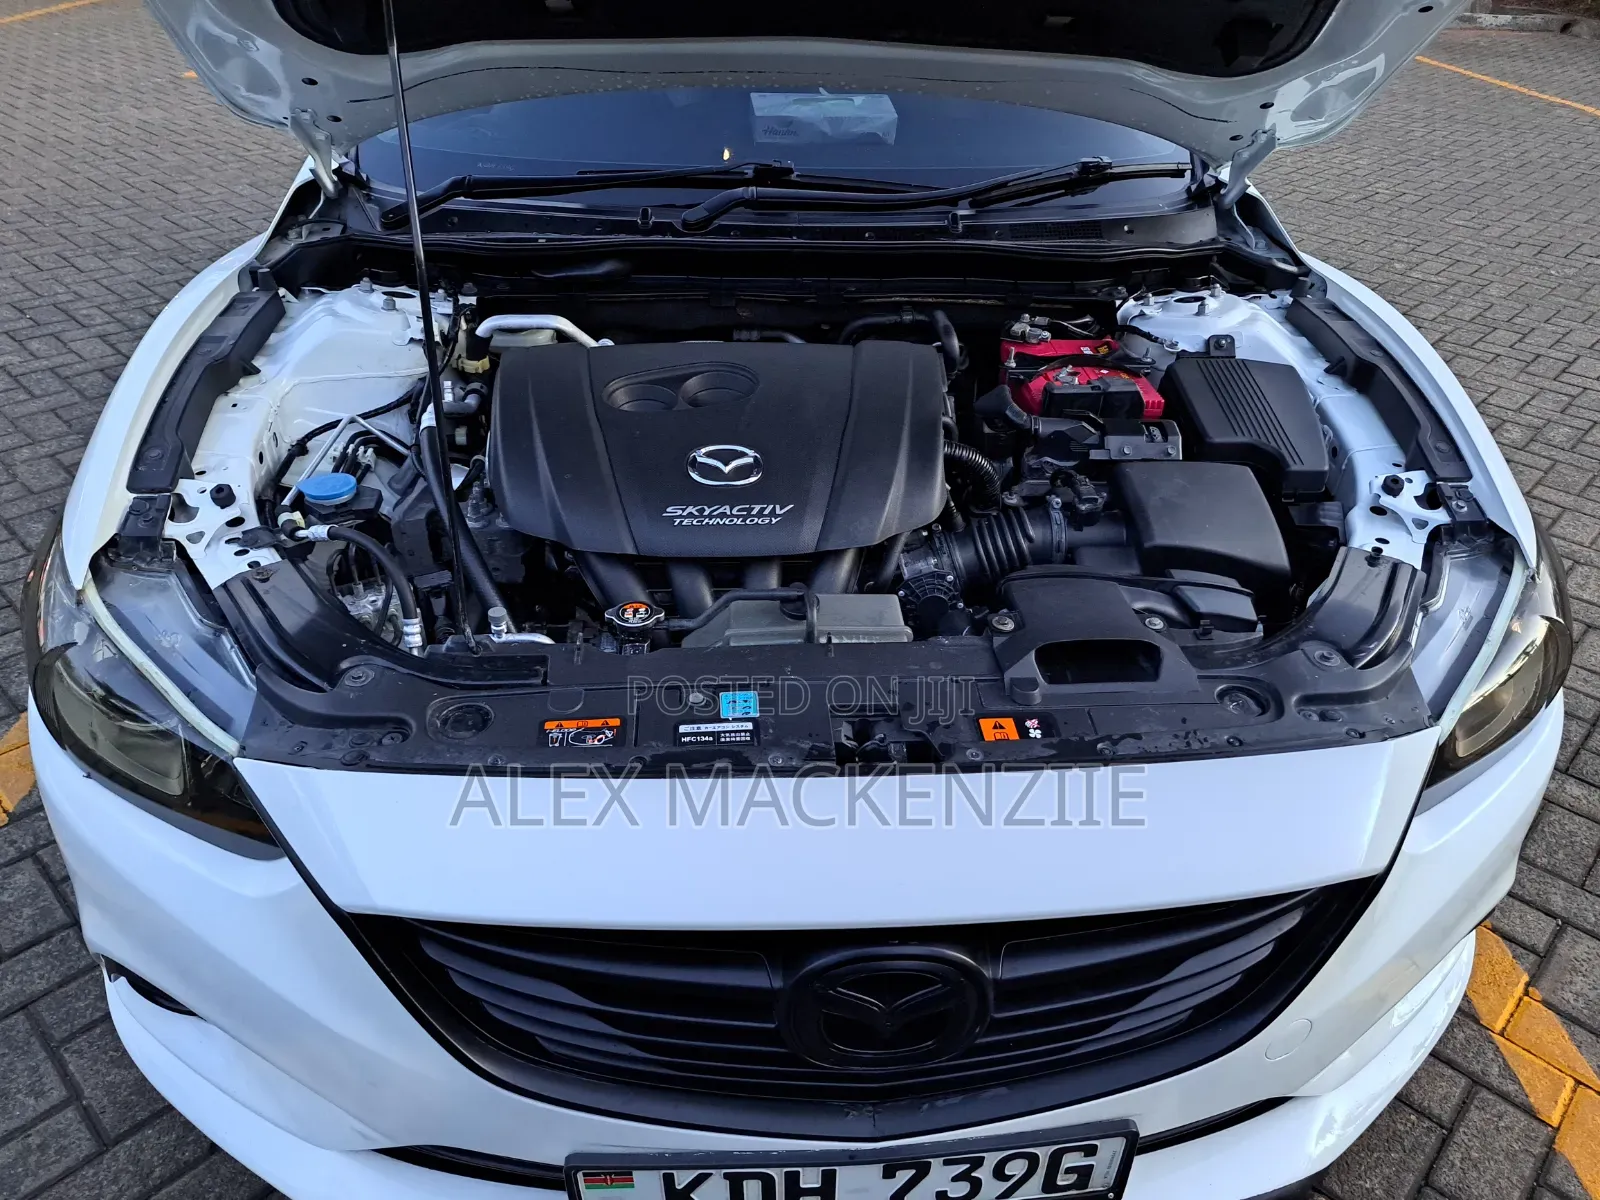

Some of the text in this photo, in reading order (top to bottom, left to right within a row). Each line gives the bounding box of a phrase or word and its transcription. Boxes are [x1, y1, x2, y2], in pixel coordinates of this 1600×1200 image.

[662, 504, 795, 517] SKYACTIV
[673, 516, 782, 526] TECHNOLOGY
[681, 735, 714, 743] HFC134a
[880, 1142, 1100, 1200] 739G
